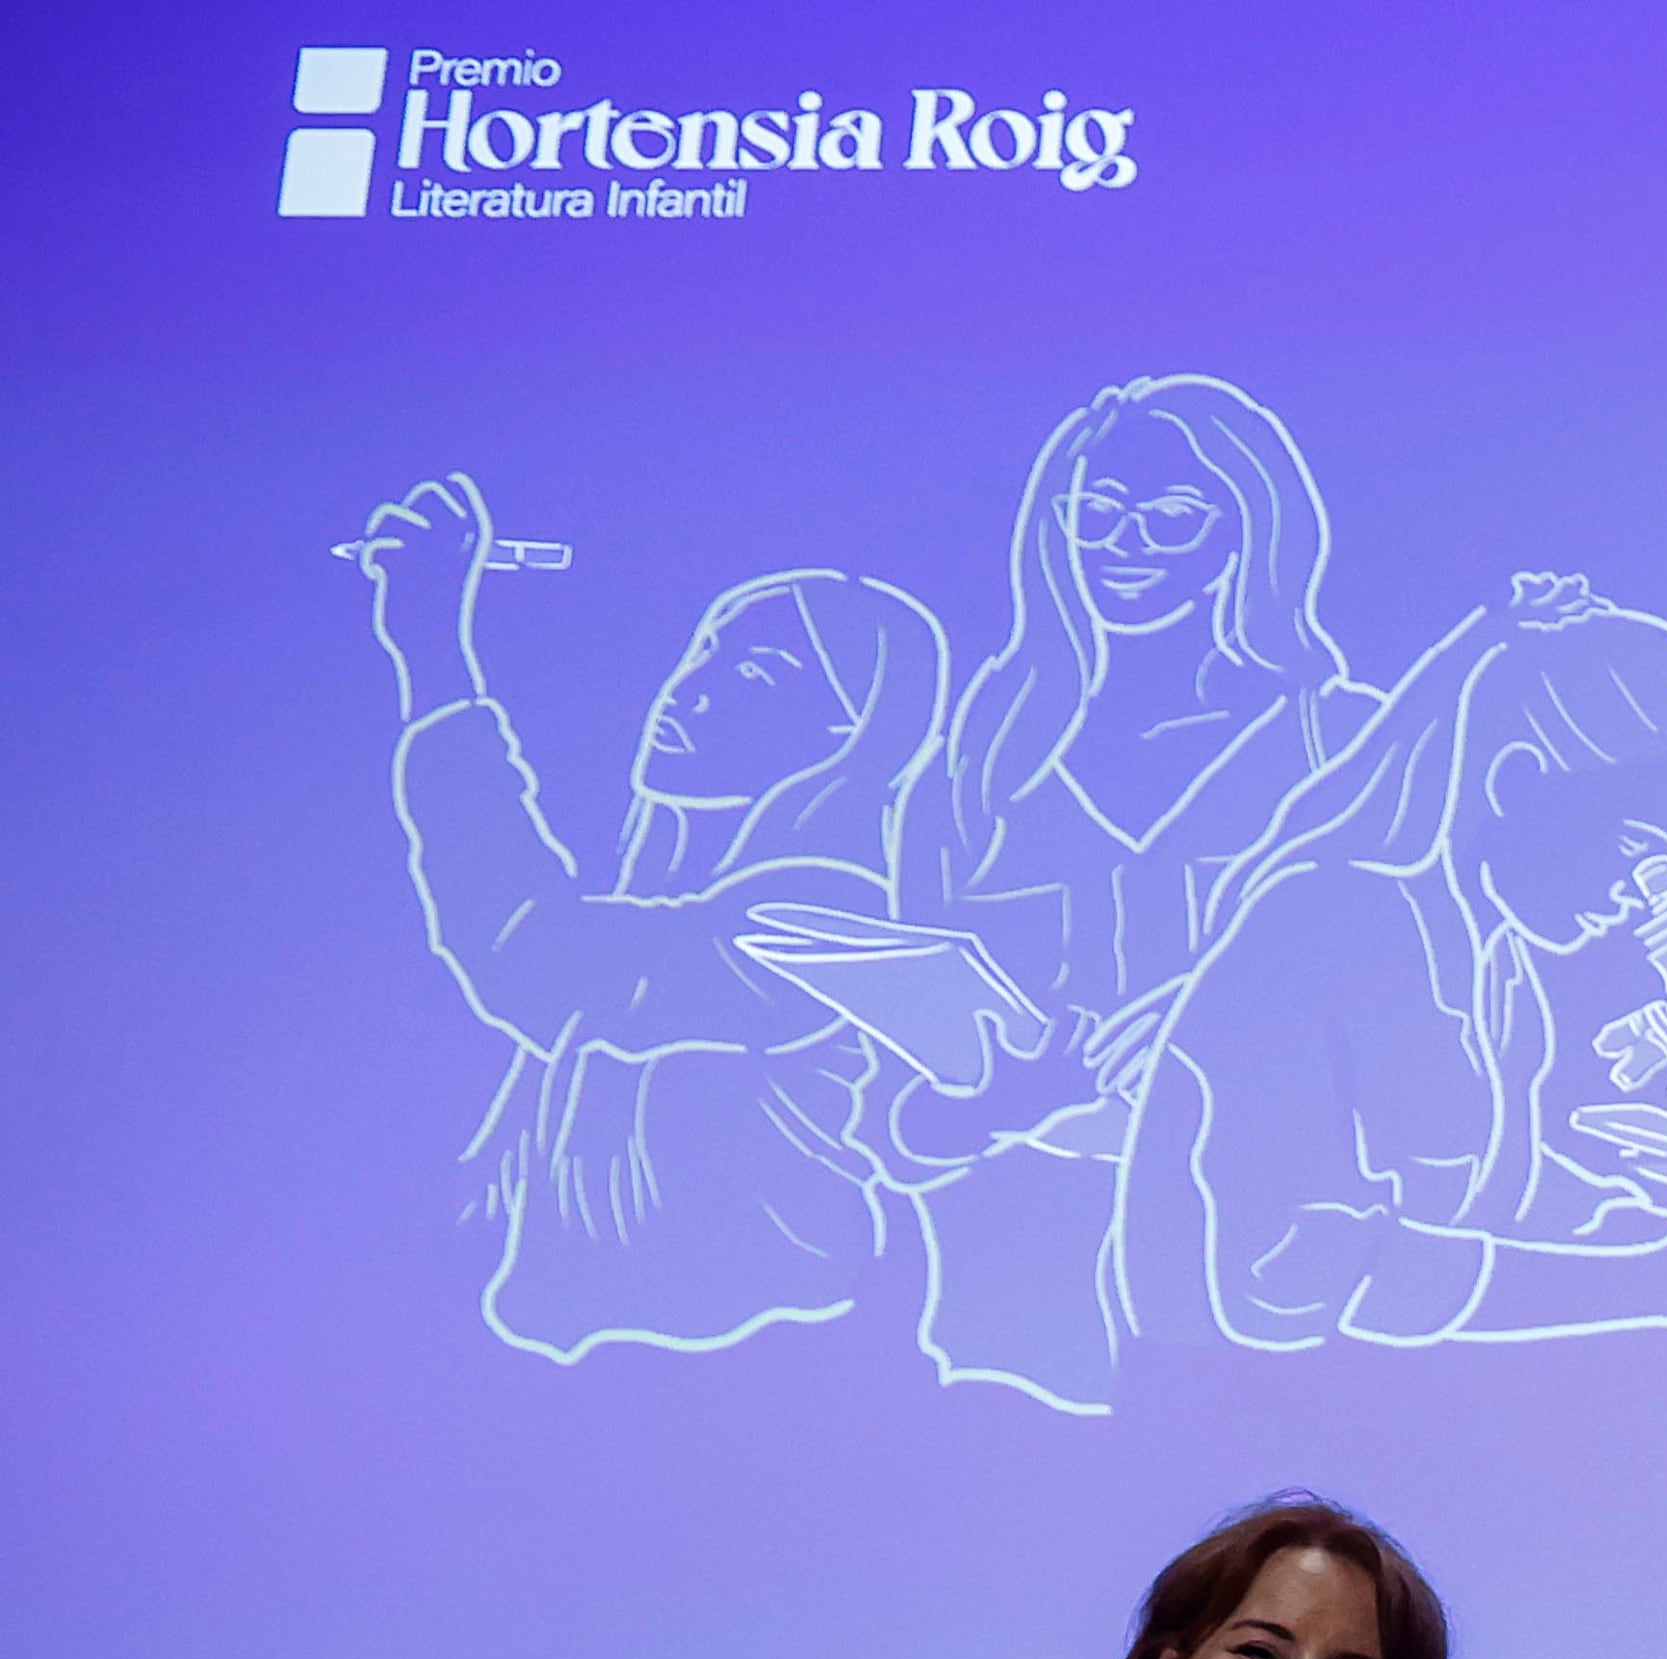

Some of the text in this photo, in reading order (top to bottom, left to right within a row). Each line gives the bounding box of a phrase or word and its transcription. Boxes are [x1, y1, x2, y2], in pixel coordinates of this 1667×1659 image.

[409, 48, 562, 87] Premio
[398, 89, 1137, 191] Hortensia Roig
[391, 178, 747, 218] Literatura Infantil
